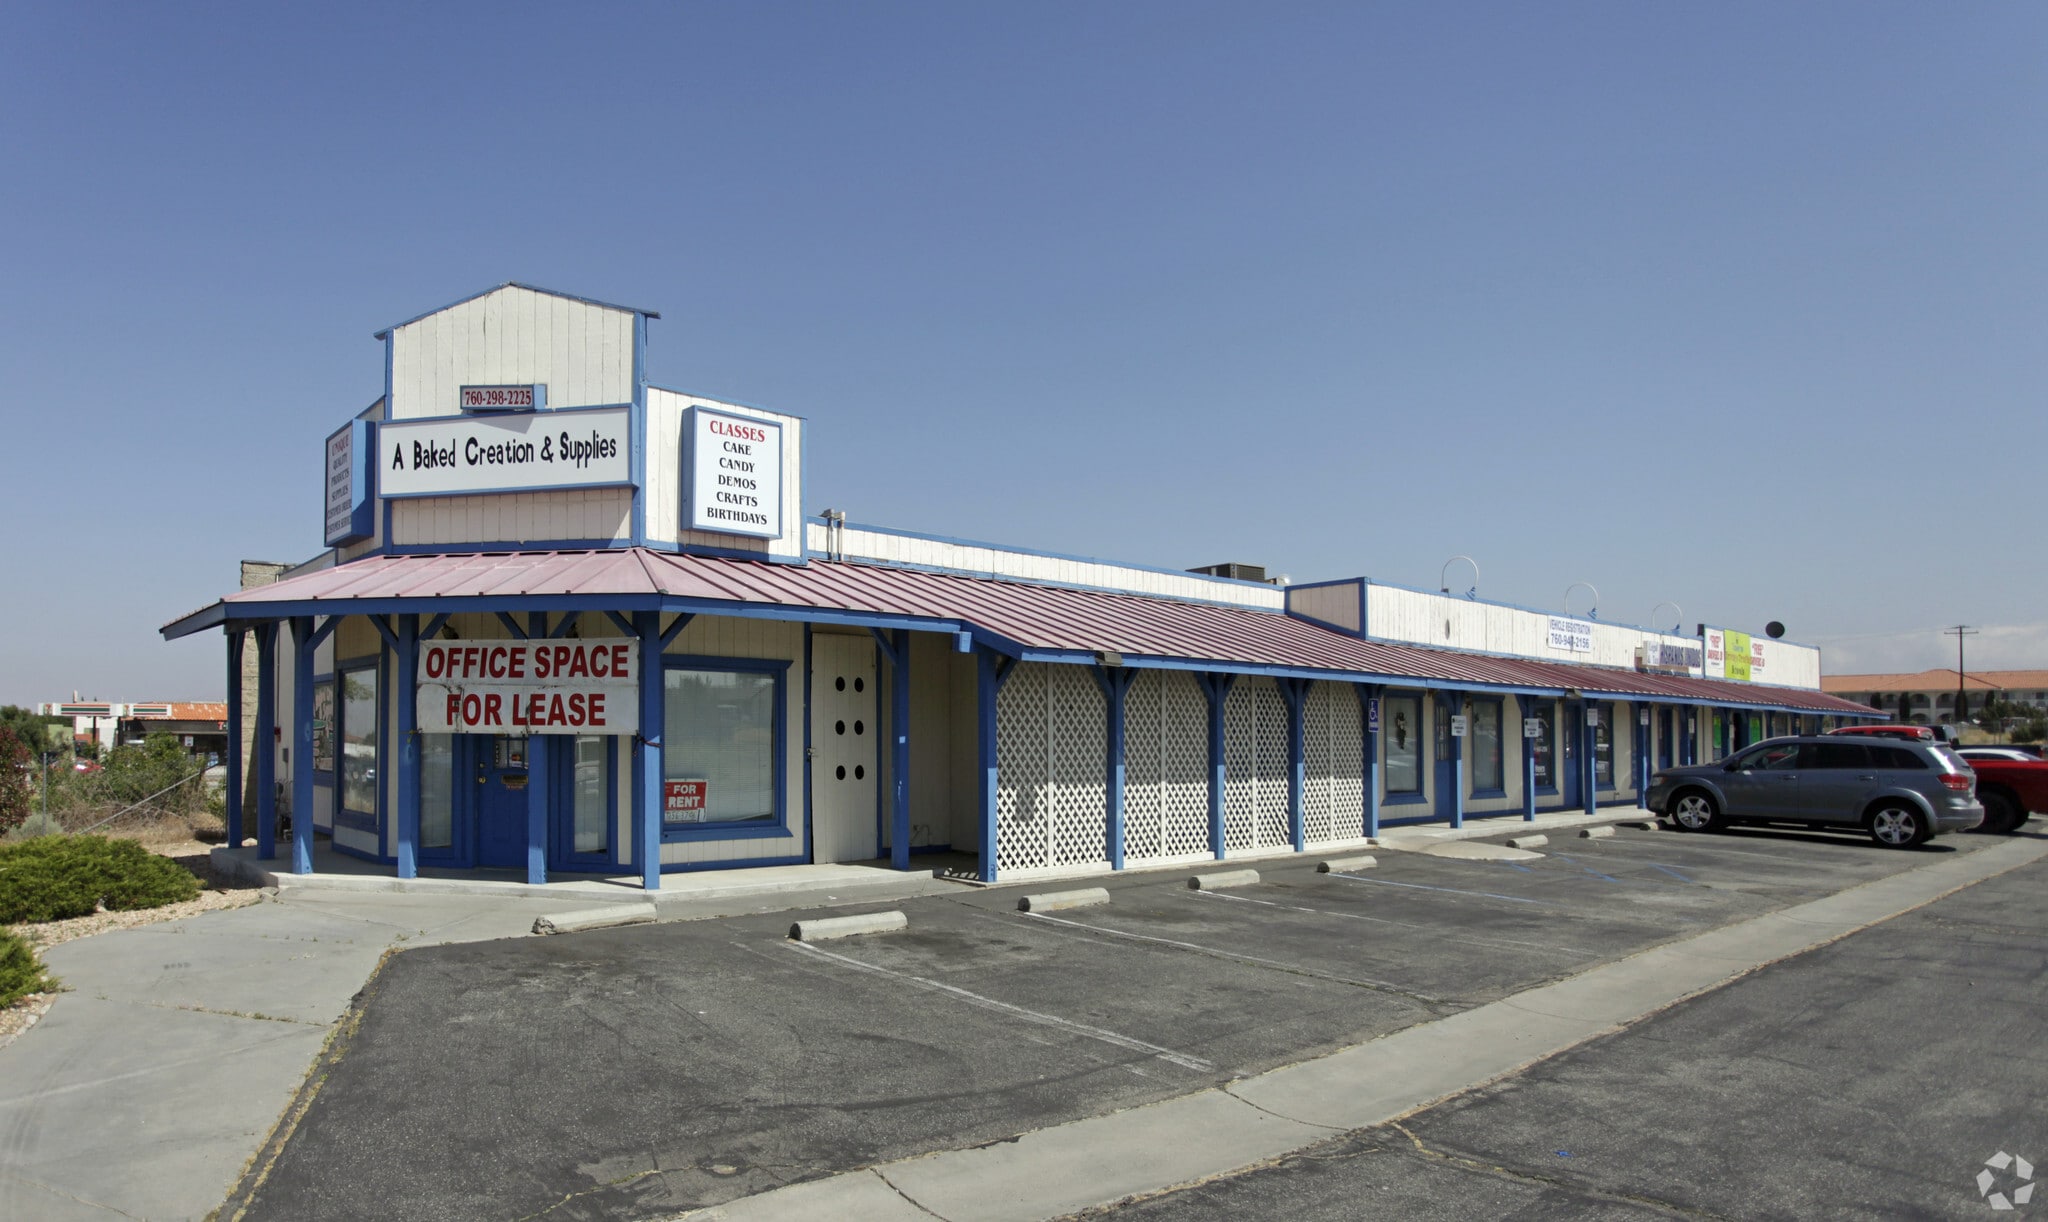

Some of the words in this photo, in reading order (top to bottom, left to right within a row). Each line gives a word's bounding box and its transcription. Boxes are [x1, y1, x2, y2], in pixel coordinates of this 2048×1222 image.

[465, 390, 532, 405] 760-298-2225
[709, 420, 765, 442] CLASSES
[392, 442, 404, 470] A
[413, 438, 456, 471] Baked
[465, 436, 534, 466] Creation
[540, 435, 554, 463] &
[560, 429, 616, 469] Supplies
[723, 441, 752, 456] CAKE
[719, 457, 755, 473] CANDY
[718, 474, 756, 490] DEMOS
[716, 491, 758, 507] CRAFTS
[707, 507, 767, 525] BIRTHDAYS
[426, 647, 526, 679] OFFICE
[534, 645, 629, 679] SPACE
[446, 693, 503, 726] FOR
[512, 693, 606, 726] LEASE
[673, 784, 697, 795] FOR
[668, 796, 701, 808] RENT
